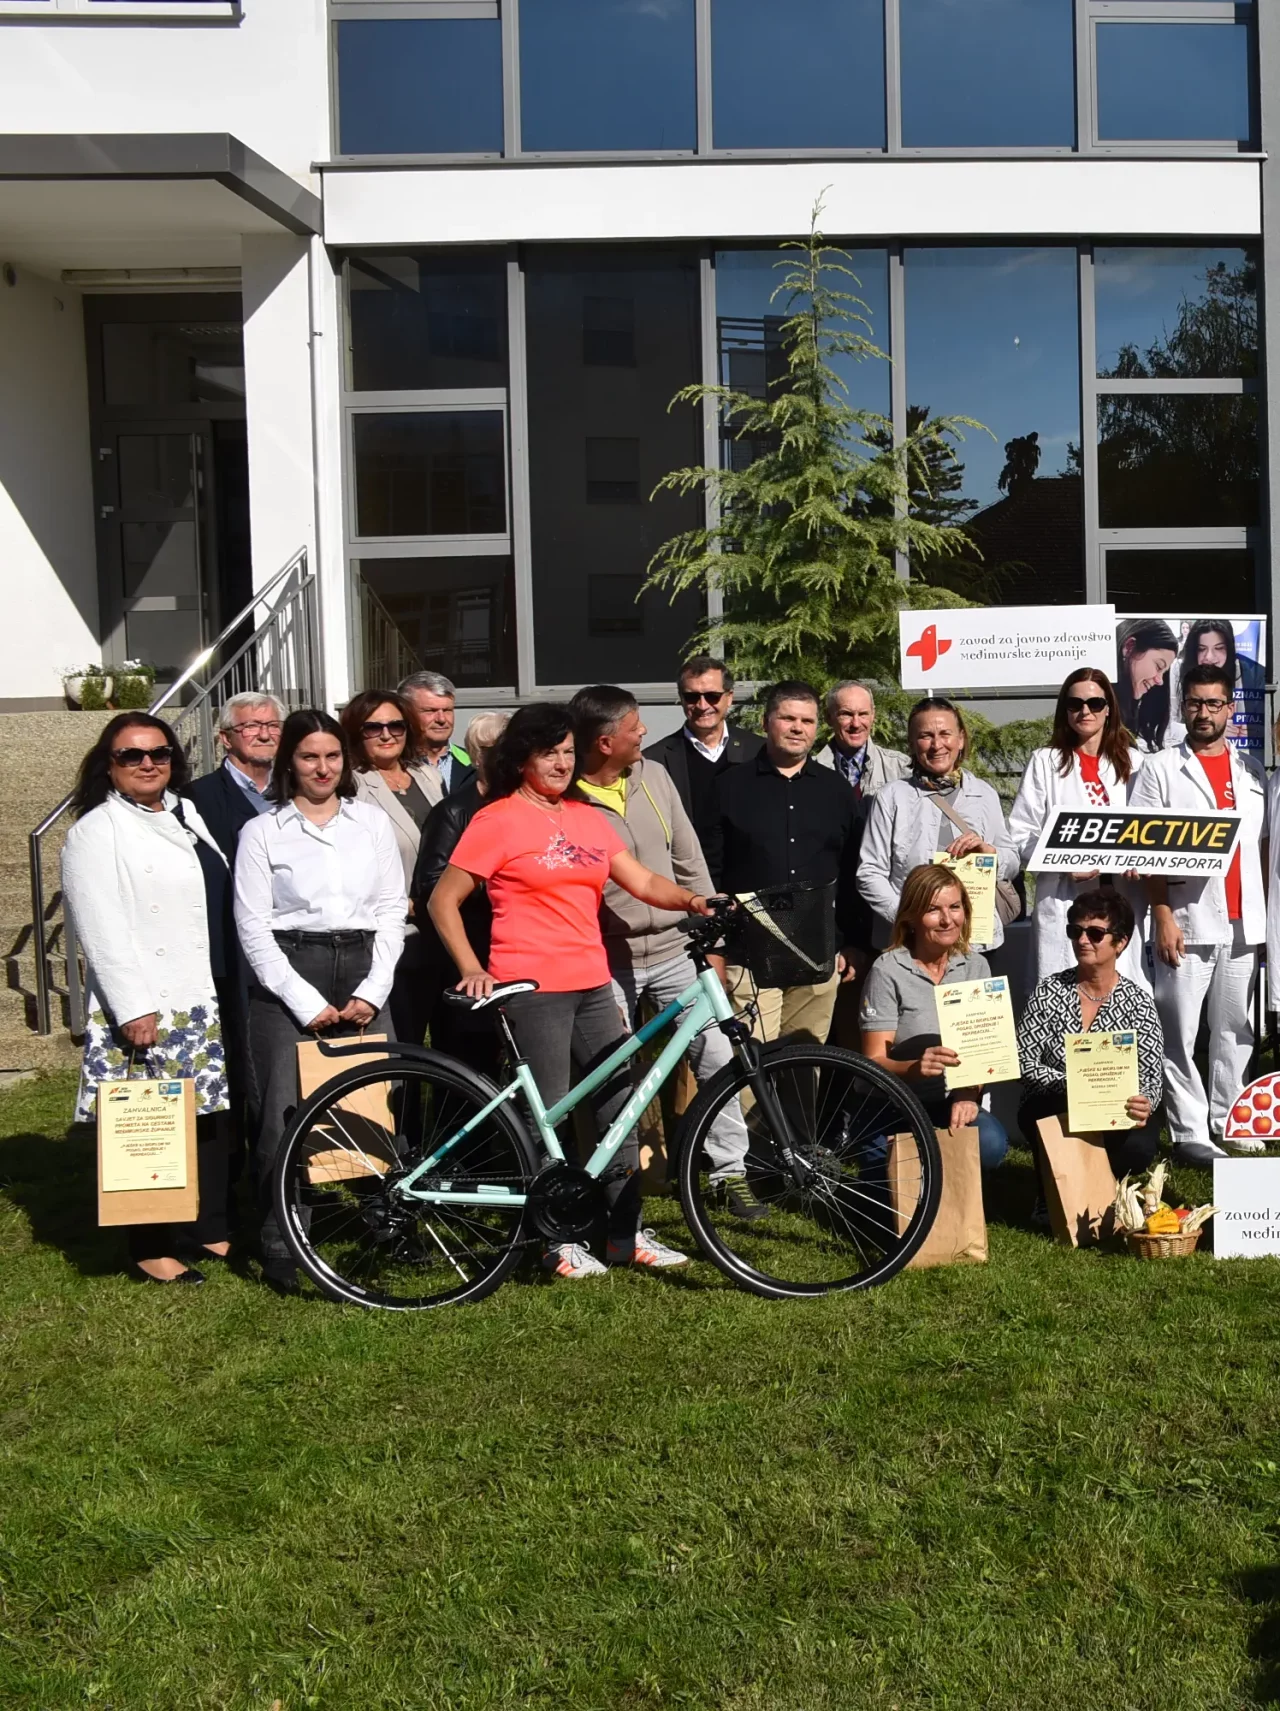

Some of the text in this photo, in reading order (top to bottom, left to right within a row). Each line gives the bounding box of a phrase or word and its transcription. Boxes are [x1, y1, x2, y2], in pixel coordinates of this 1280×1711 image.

[959, 632, 1111, 647] zavod za javno zdravstvo
[1034, 646, 1087, 660] županije
[1058, 818, 1232, 848] #BEACTIVE
[1042, 854, 1223, 870] EUROPSKI TJEDAN SPORTA
[605, 1067, 661, 1149] CTM
[1225, 1208, 1270, 1221] zavod
